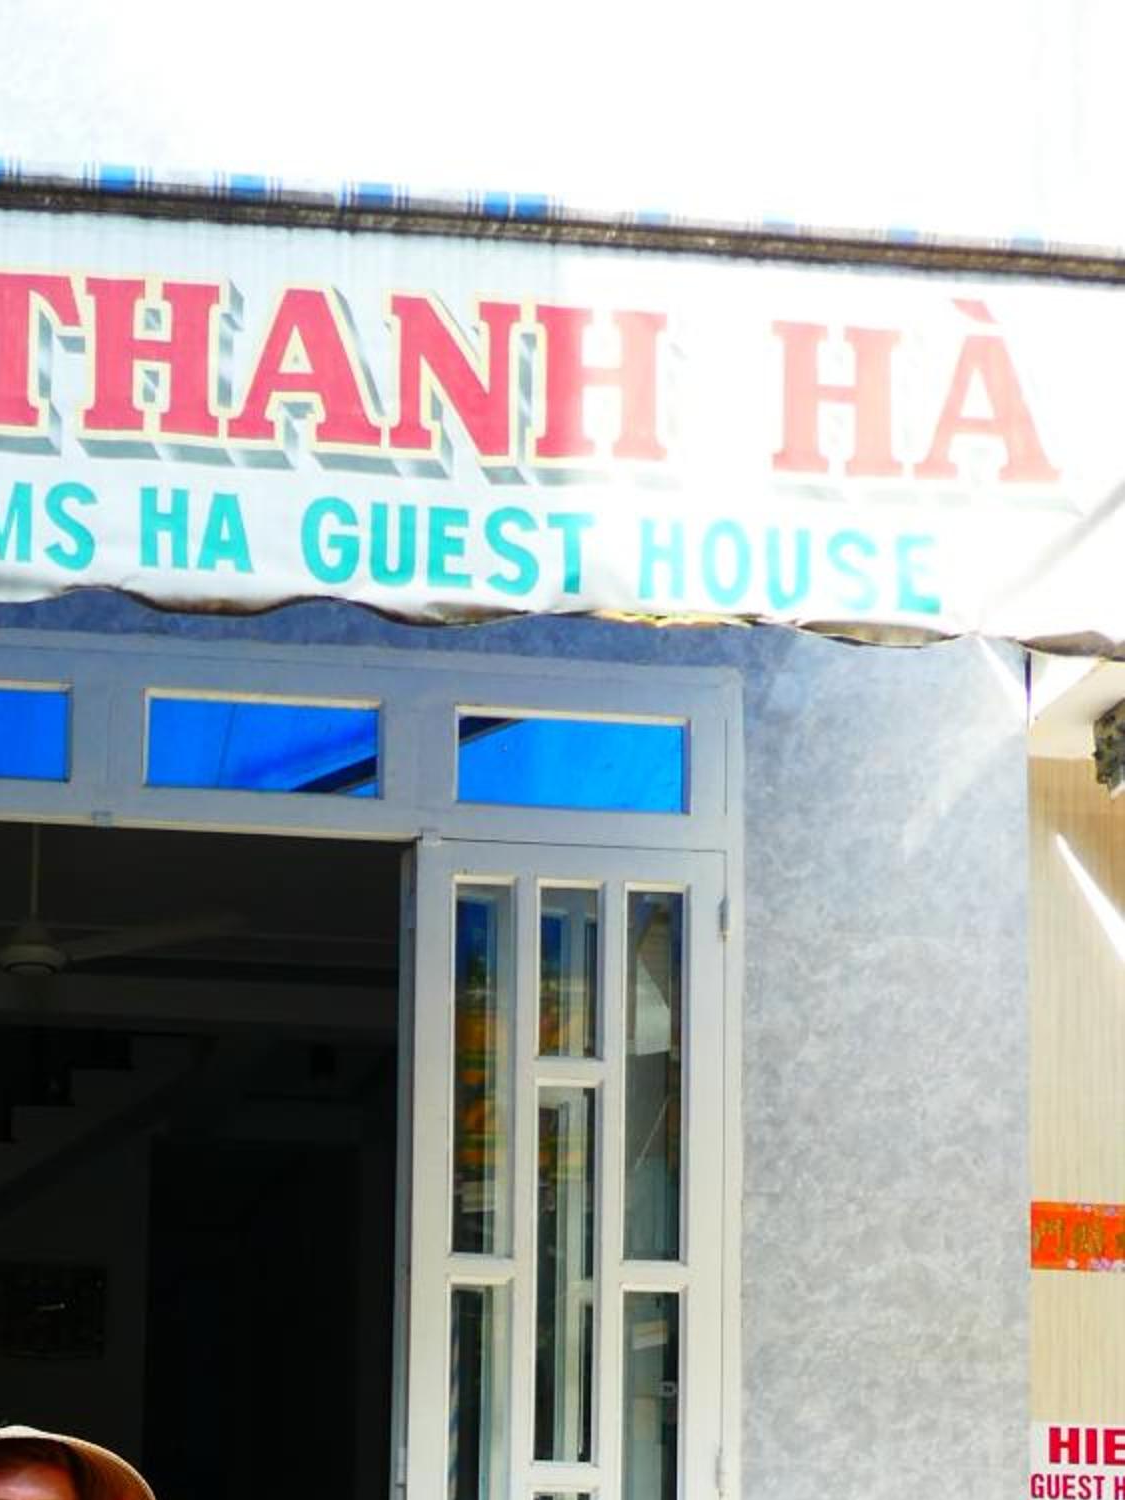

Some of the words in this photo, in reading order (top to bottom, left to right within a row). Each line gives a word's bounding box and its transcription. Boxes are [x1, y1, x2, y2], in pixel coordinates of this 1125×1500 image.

[772, 299, 1061, 482] HÀ
[141, 486, 253, 576] HA
[300, 496, 597, 594] GUEST
[638, 516, 943, 616] HOUSE
[1030, 1473, 1106, 1500] GUEST
